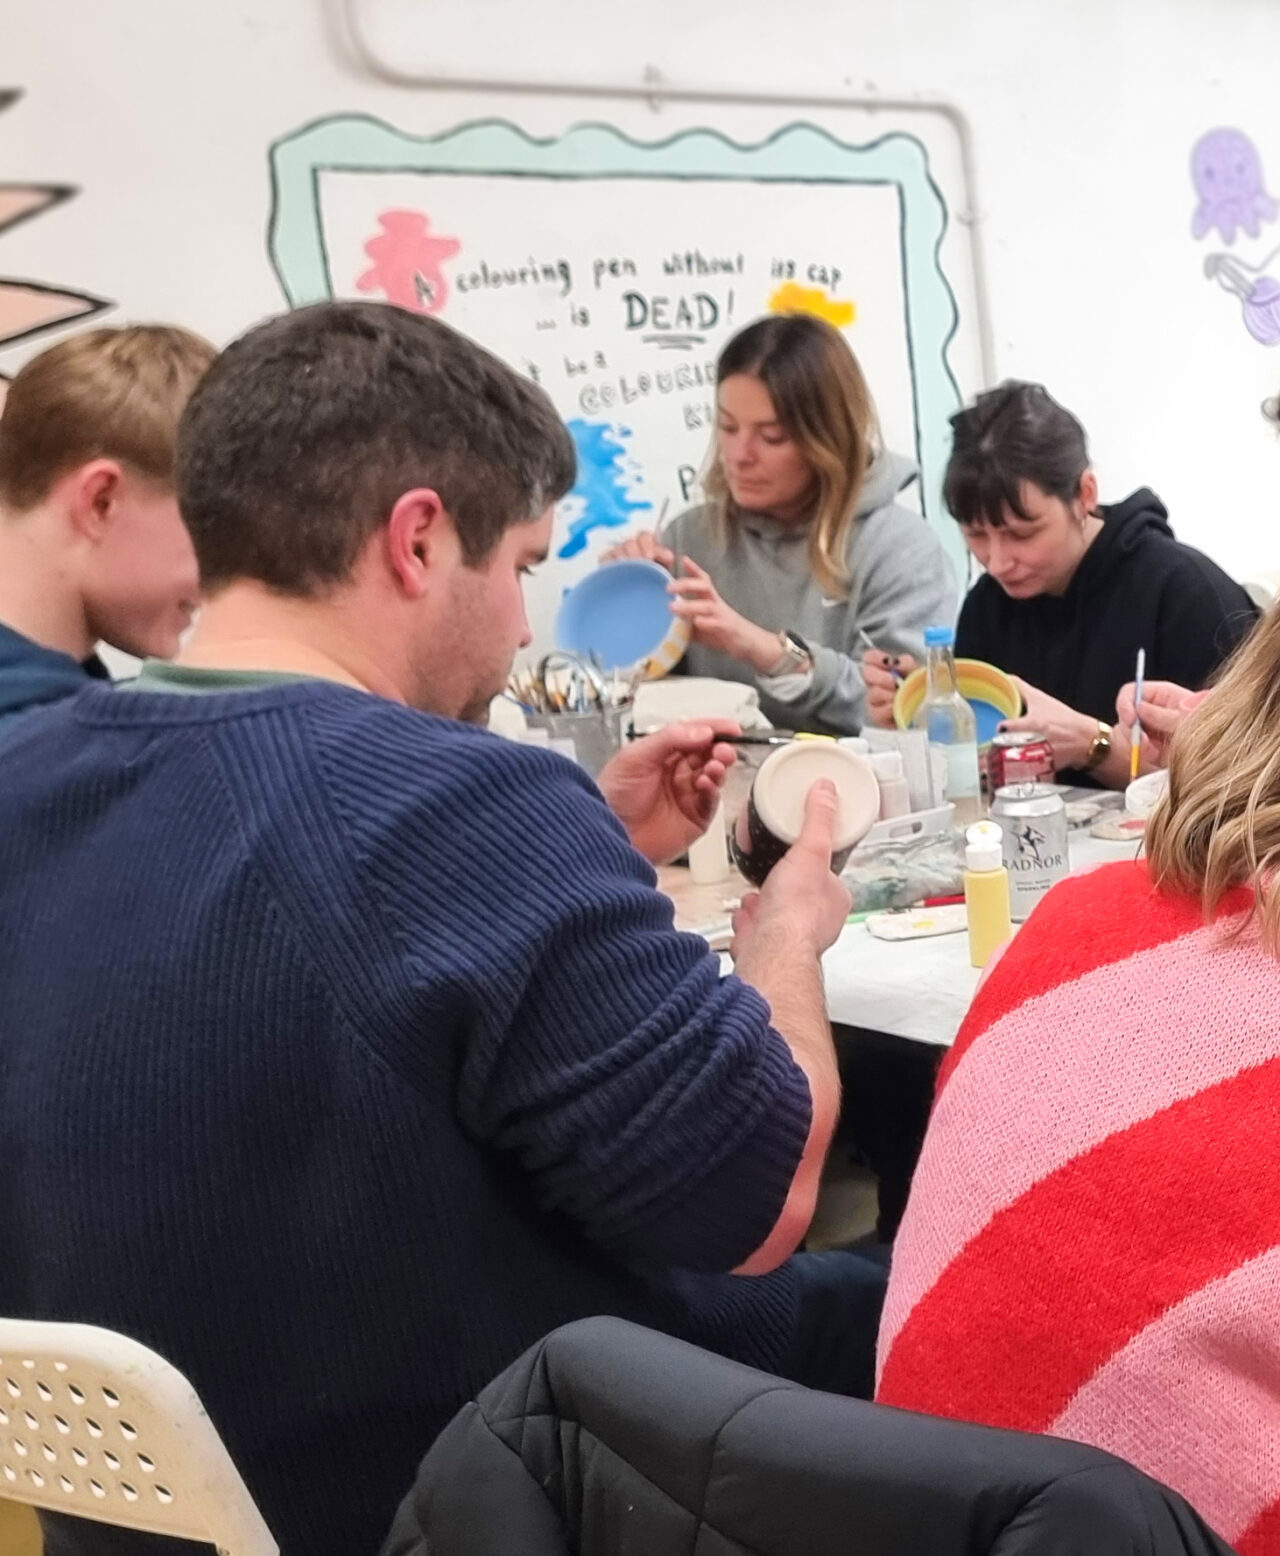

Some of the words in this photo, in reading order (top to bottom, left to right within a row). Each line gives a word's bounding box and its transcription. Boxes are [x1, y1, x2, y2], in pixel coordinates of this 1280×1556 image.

[456, 256, 572, 298] colouring
[593, 258, 638, 290] pen
[663, 249, 745, 276] without
[806, 264, 842, 292] cap
[570, 302, 590, 328] is
[622, 288, 734, 330] DEAD!
